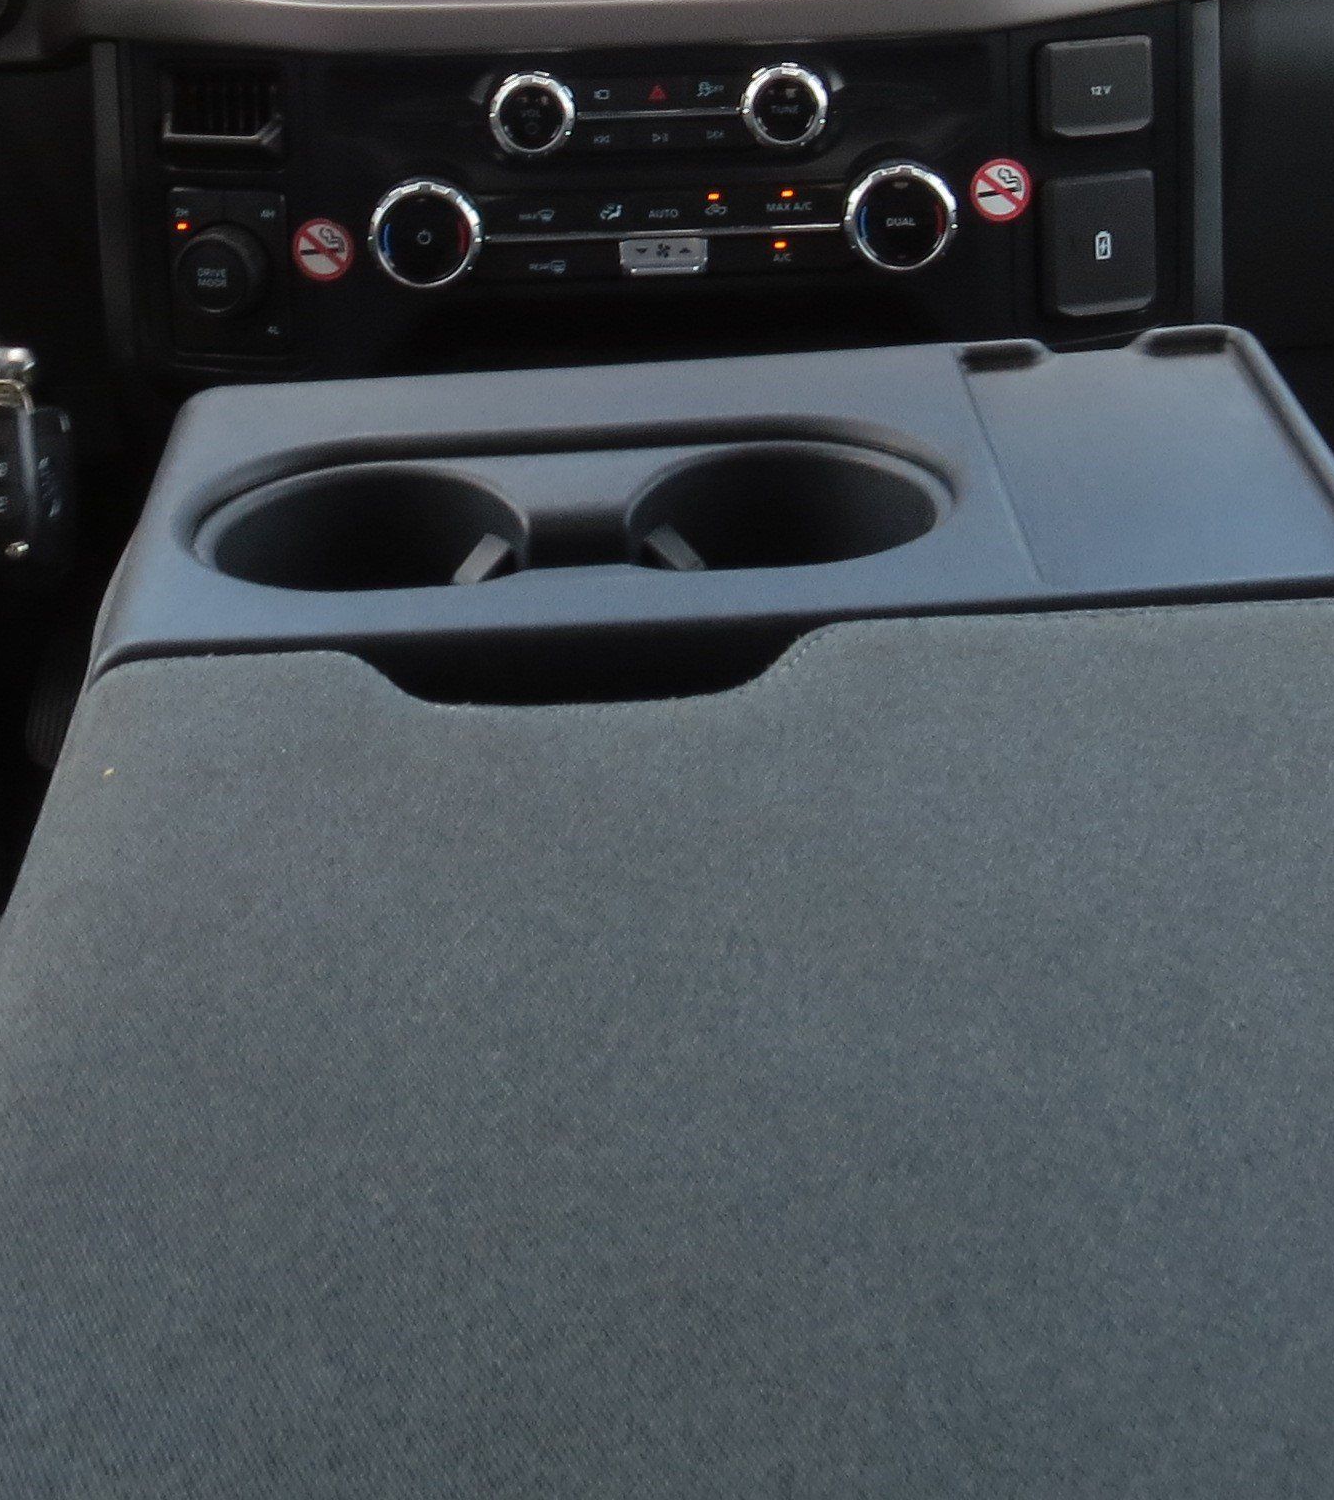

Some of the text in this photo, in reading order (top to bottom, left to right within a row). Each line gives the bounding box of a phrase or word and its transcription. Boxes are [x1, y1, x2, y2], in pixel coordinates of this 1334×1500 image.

[765, 202, 790, 212] MAX
[648, 208, 679, 220] AUTO
[885, 217, 916, 227] DUAL
